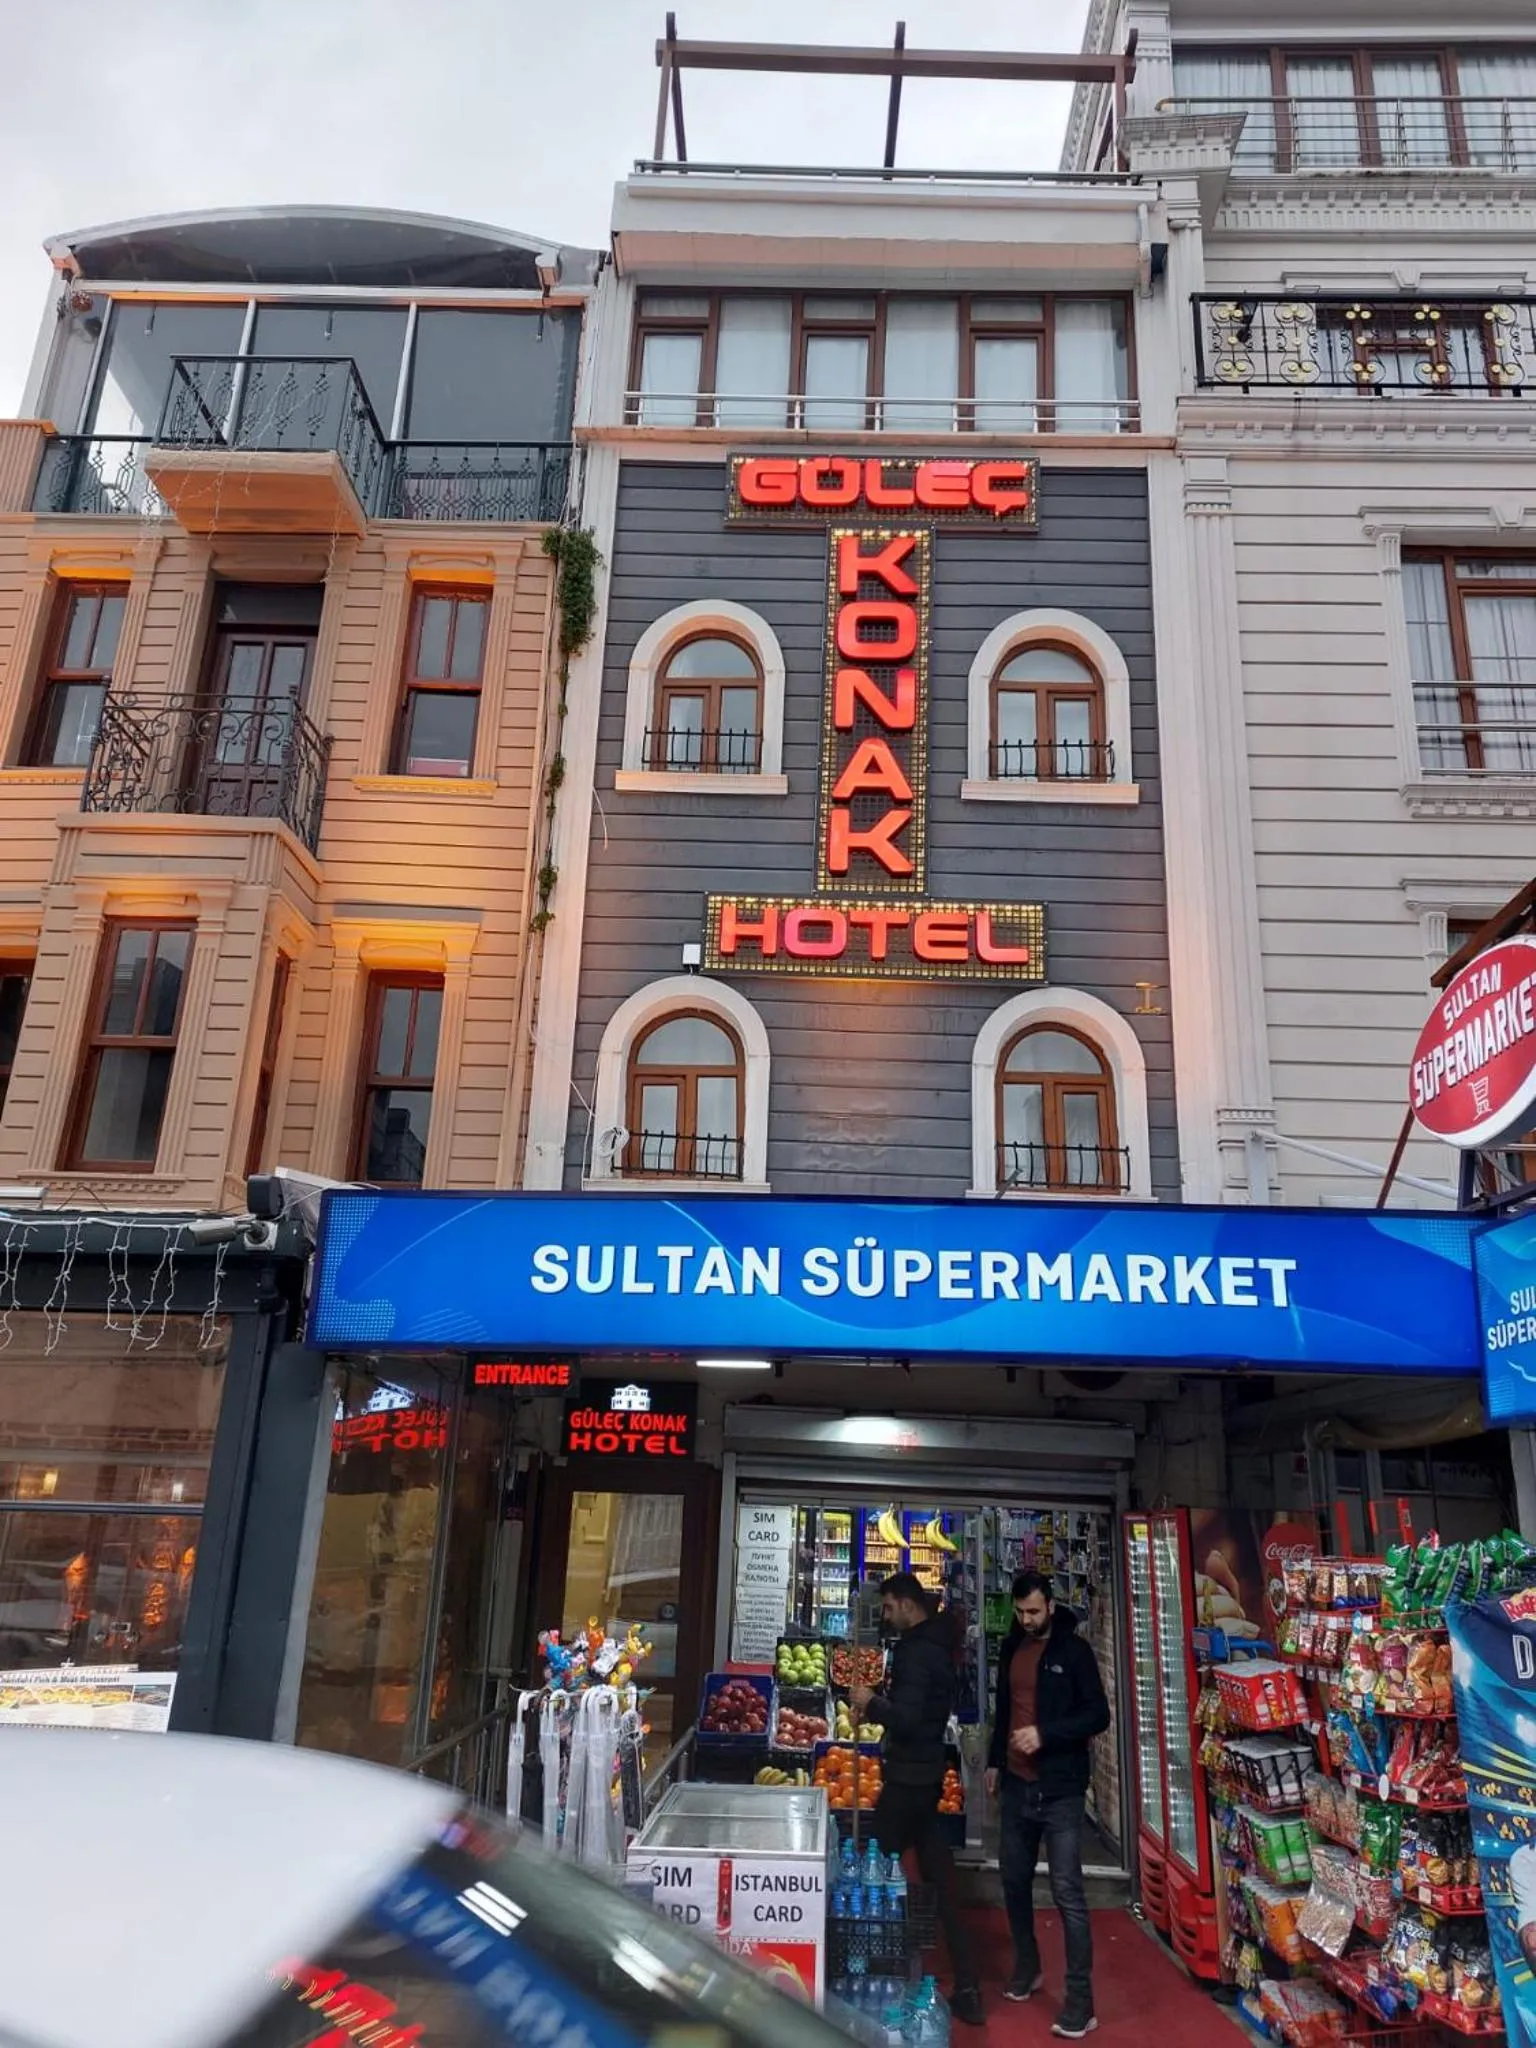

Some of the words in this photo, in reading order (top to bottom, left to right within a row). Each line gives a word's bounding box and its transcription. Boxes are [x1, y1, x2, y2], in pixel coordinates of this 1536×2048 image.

[828, 534, 918, 876] KONAK
[719, 902, 1029, 965] HOTEL
[1441, 963, 1501, 1031] SULTAN
[530, 1243, 782, 1297] SULTAN
[801, 1236, 1298, 1309] SÜPERMARKET
[475, 1364, 571, 1386] ENTRANCE
[570, 1407, 625, 1431] GÜLEÇ
[629, 1413, 687, 1432] KONAK
[569, 1432, 687, 1455] HOTEL
[753, 1512, 776, 1524] SIM
[747, 1530, 780, 1543] CARD
[651, 1866, 692, 1888] SIM
[735, 1874, 823, 1893] ISTANBUL
[657, 1903, 701, 1926] ARD
[753, 1904, 804, 1923] CARD
